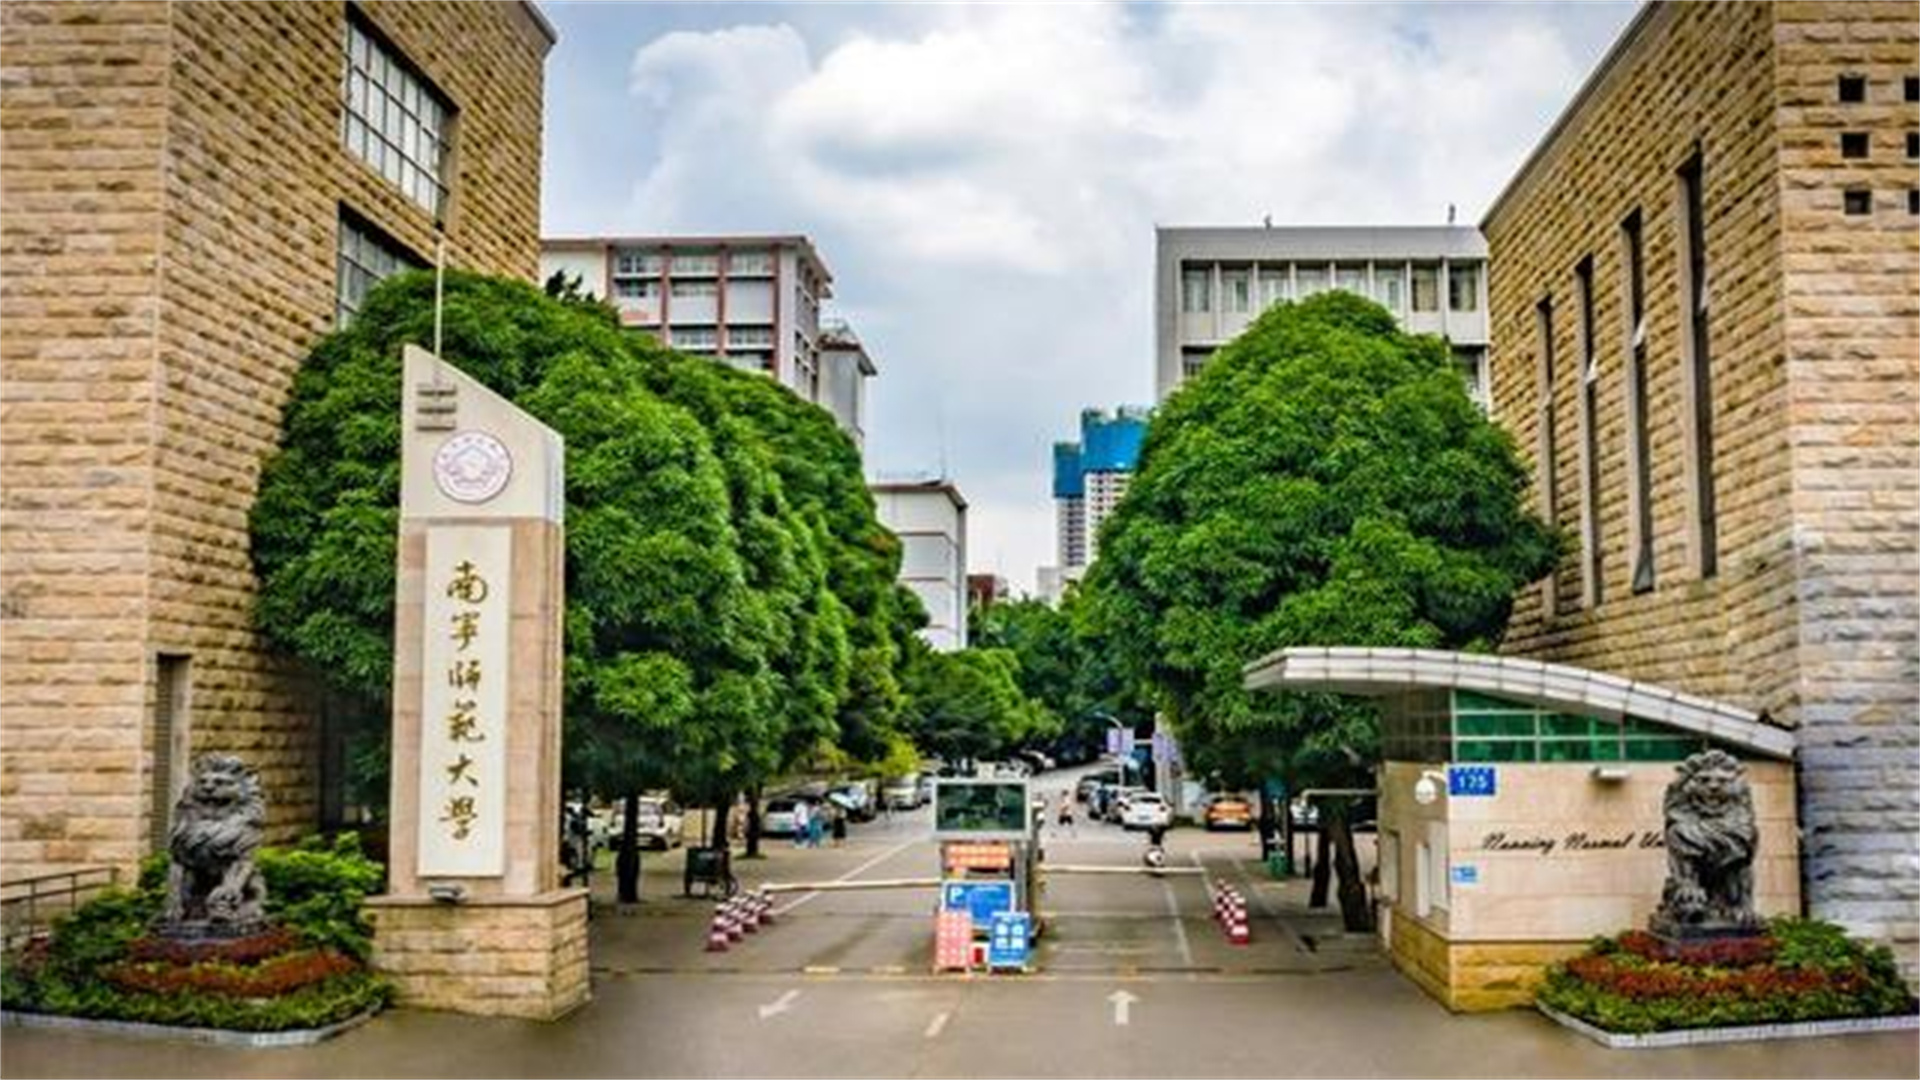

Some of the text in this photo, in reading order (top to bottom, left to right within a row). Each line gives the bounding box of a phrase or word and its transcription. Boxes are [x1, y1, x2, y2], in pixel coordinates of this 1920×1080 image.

[1483, 832, 1555, 854] Nanning
[1564, 831, 1635, 849] Normal
[950, 886, 964, 903] P
